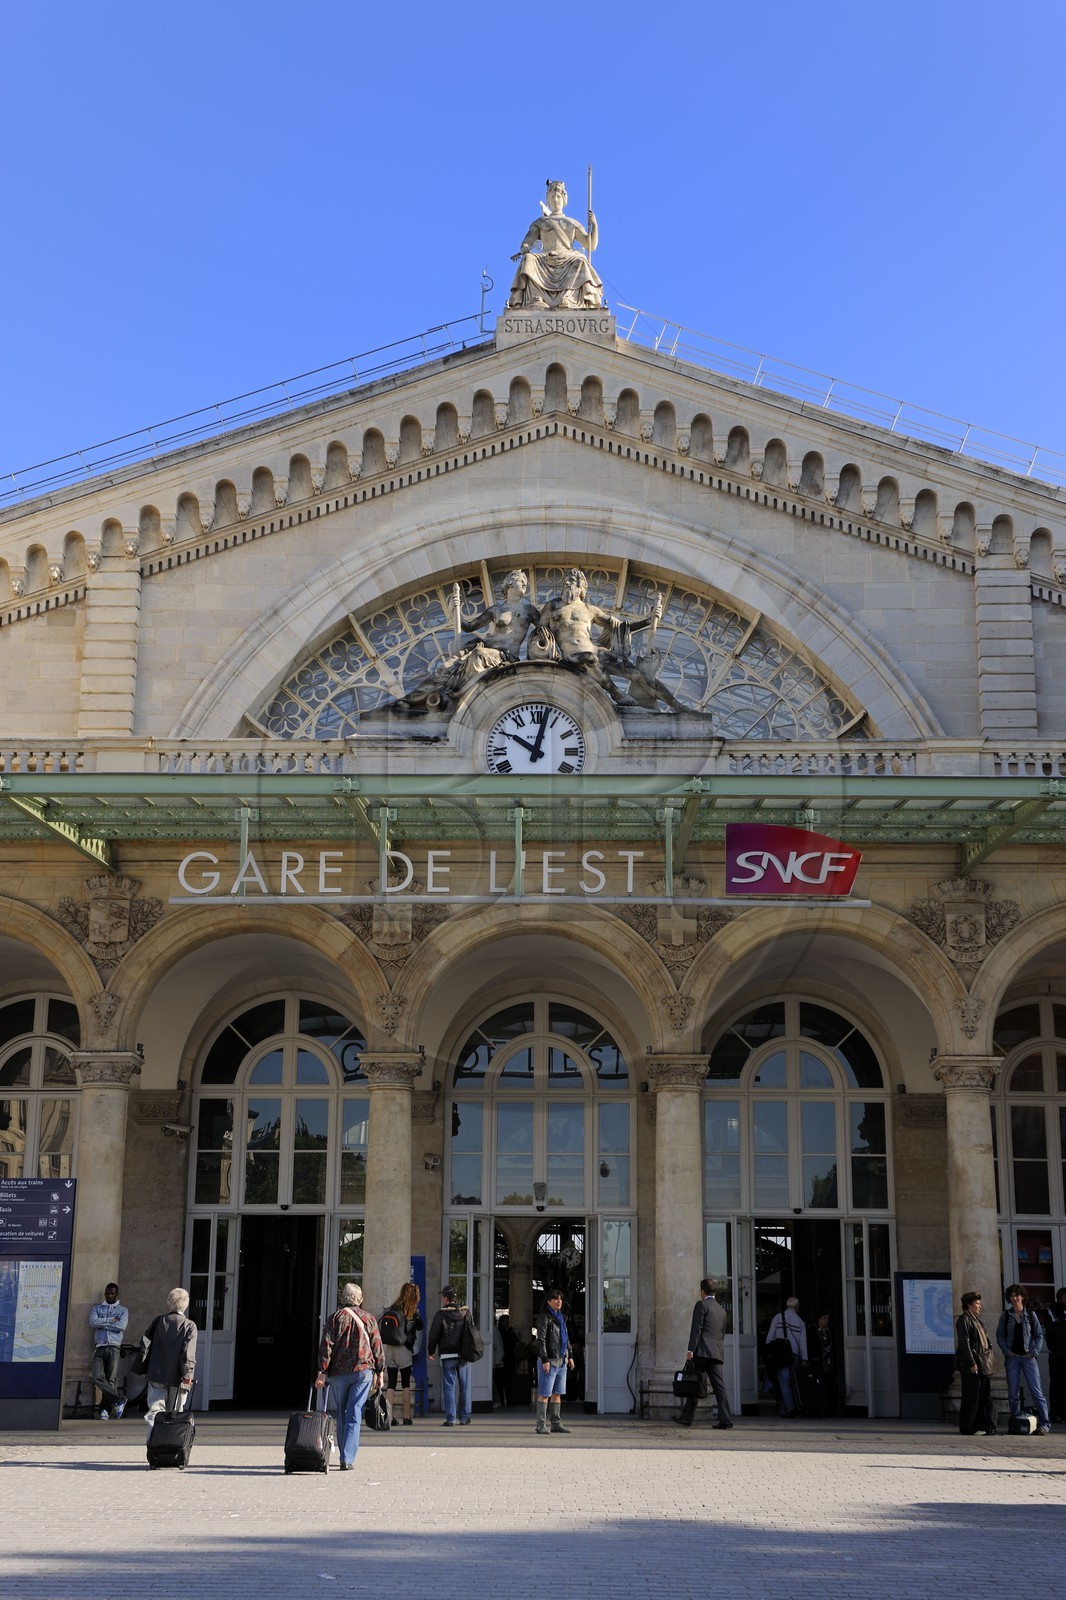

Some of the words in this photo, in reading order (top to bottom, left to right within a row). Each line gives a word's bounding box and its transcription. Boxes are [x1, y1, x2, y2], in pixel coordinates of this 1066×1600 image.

[504, 318, 609, 334] STRASBOVRG
[178, 851, 344, 894] GARE
[381, 851, 450, 893] DE
[731, 851, 854, 884] SNCF
